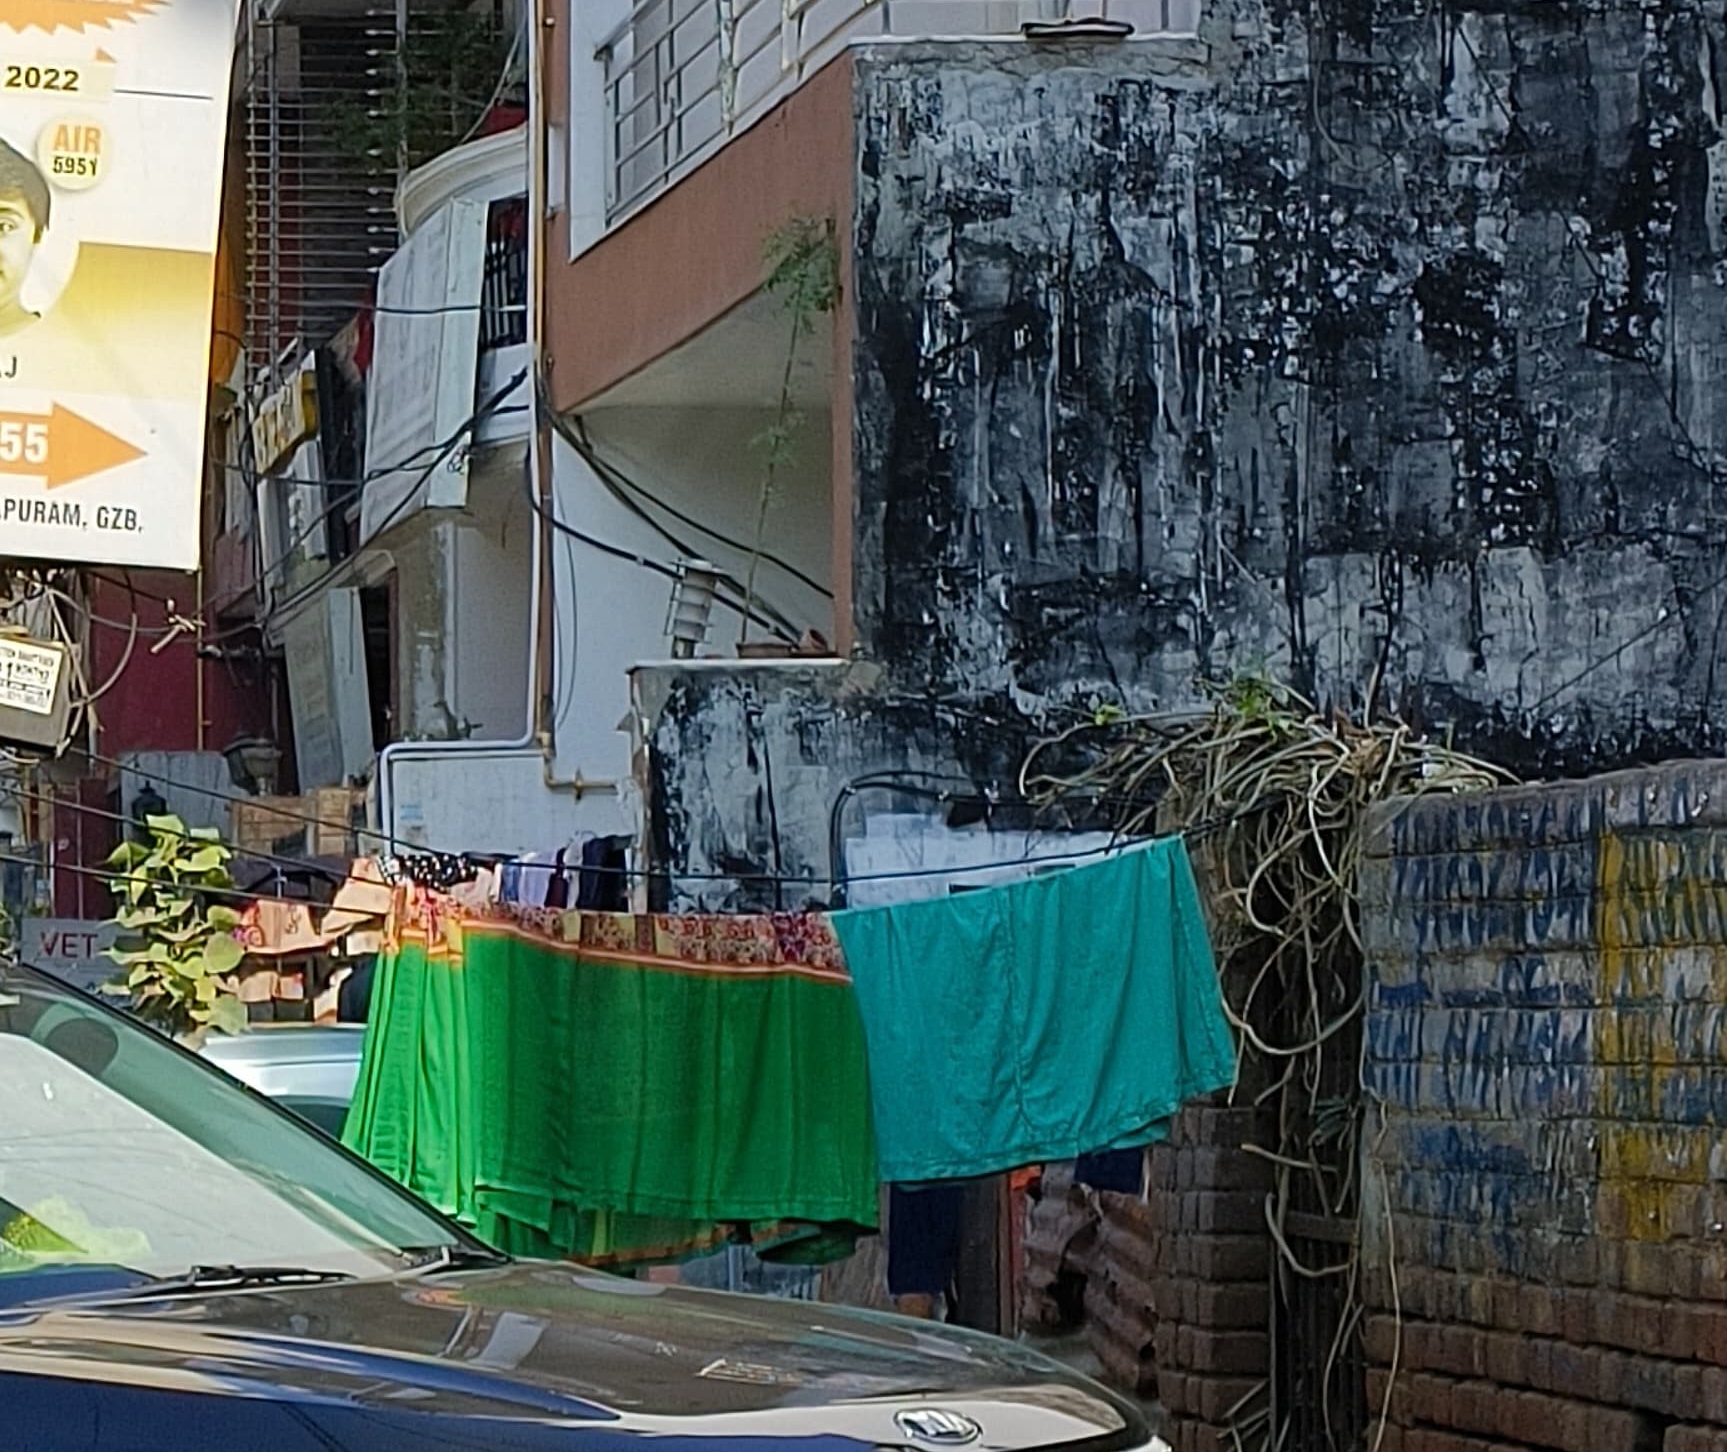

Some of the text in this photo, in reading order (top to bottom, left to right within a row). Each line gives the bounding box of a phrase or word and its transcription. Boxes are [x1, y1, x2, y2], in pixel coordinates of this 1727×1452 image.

[5, 65, 80, 92] 2022
[52, 124, 101, 154] AIR
[40, 931, 99, 960] VET
